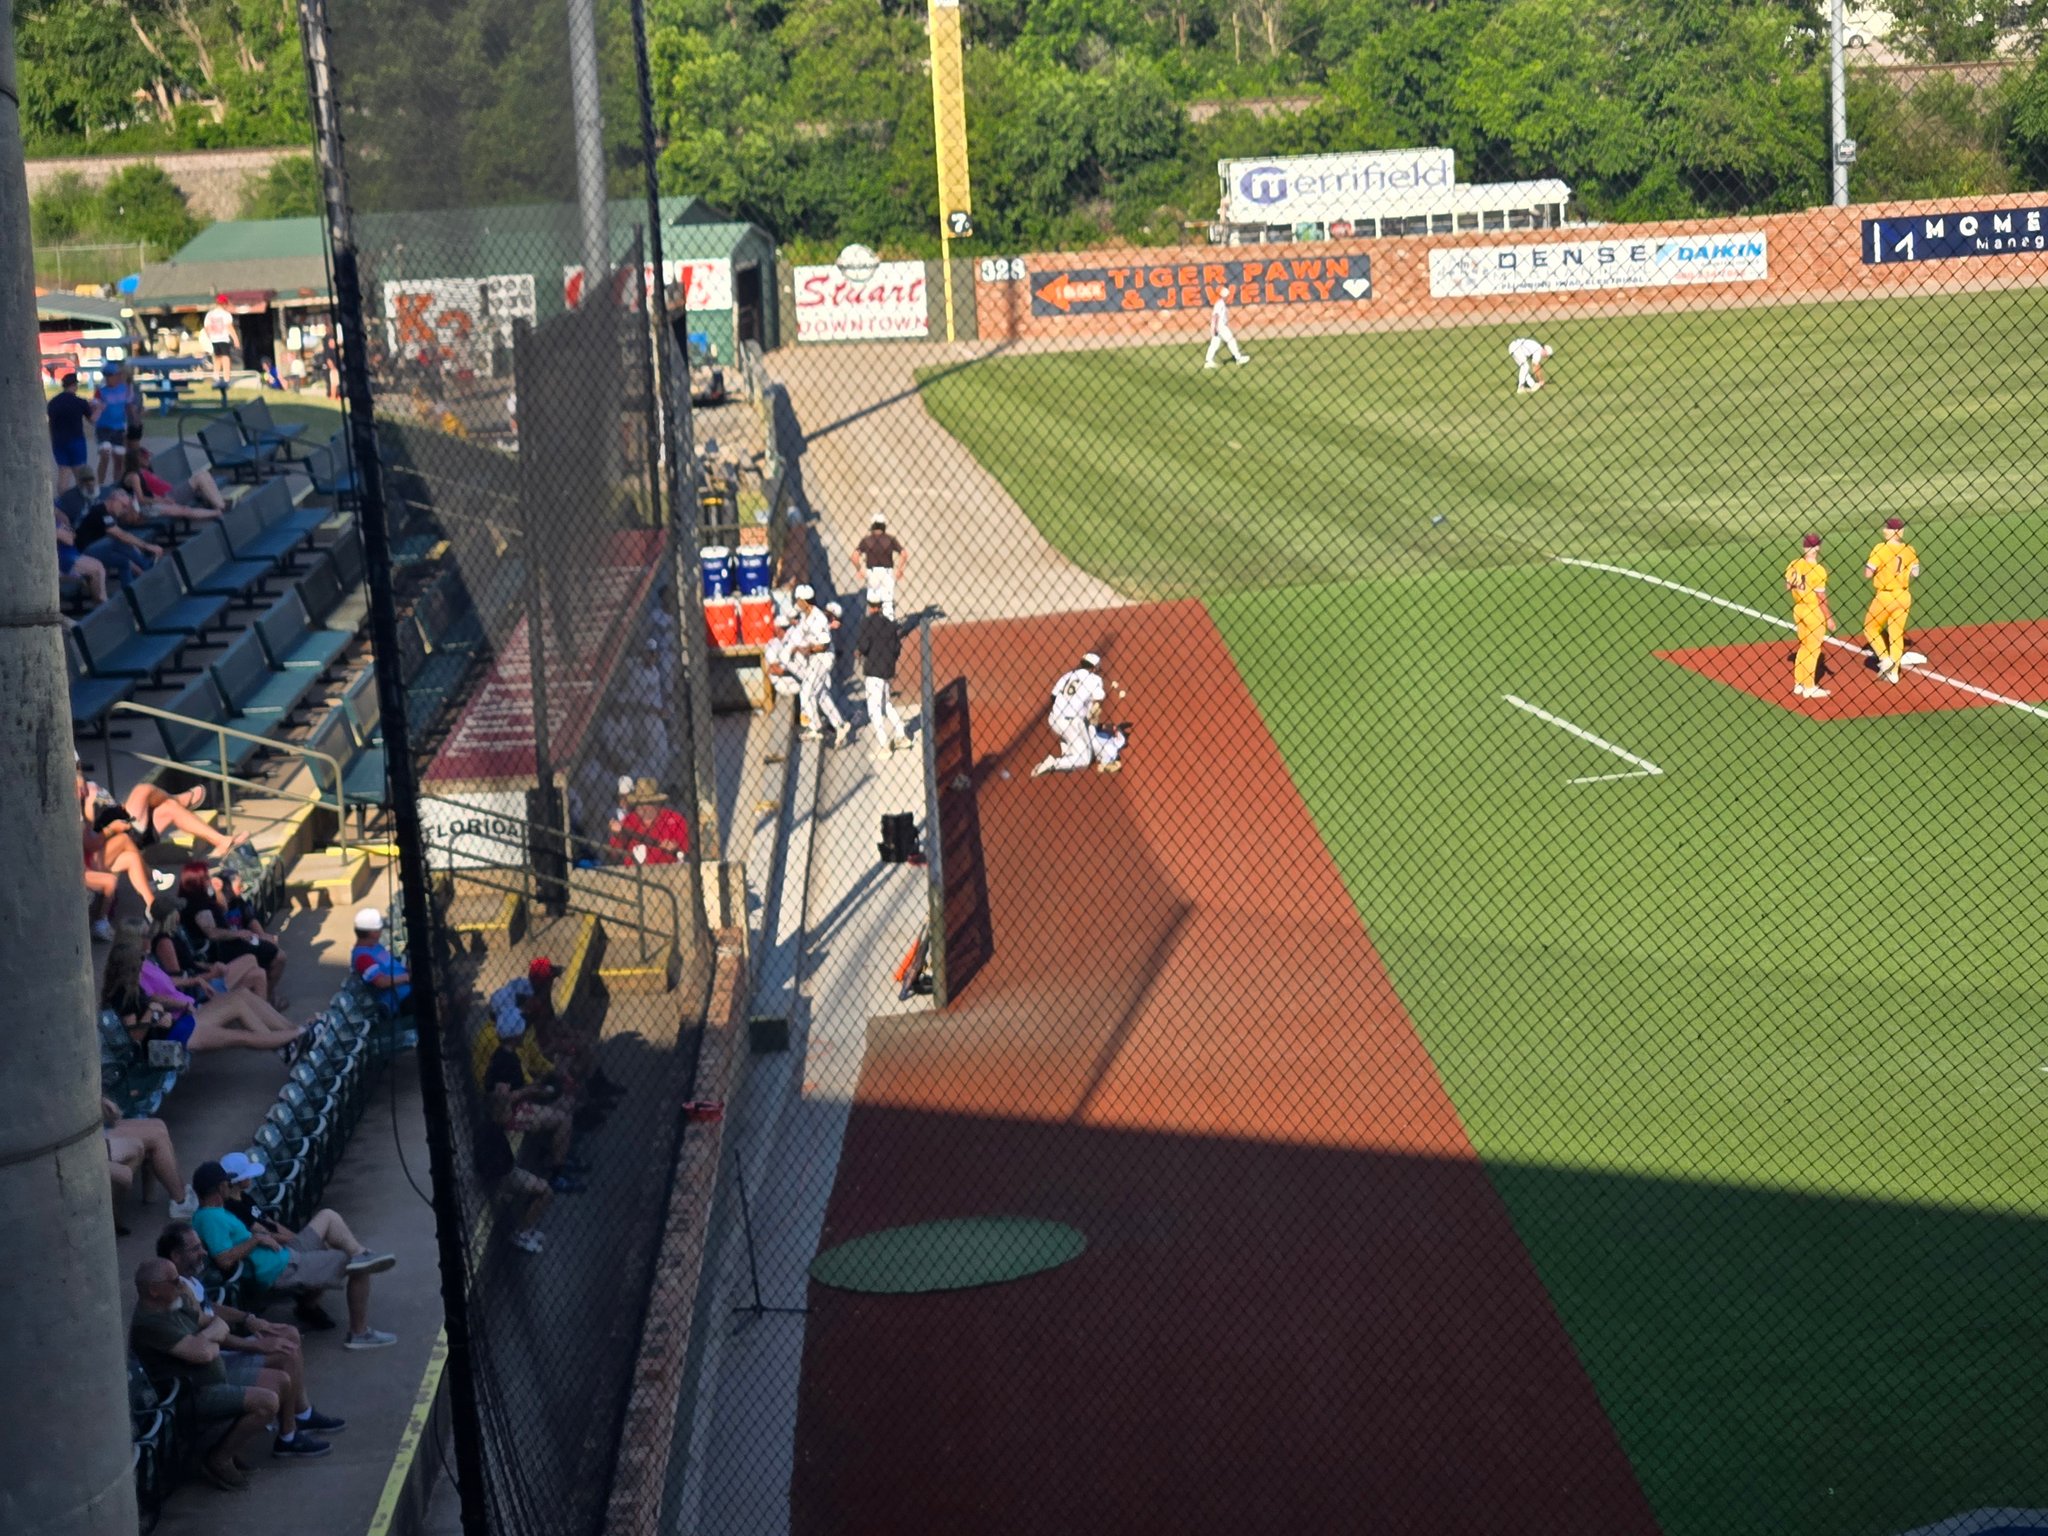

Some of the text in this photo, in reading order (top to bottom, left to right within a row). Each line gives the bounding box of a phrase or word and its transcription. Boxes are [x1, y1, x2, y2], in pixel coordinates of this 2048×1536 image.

[1499, 245, 1646, 269] DENSE
[1677, 241, 1762, 262] DAIKIN
[1108, 258, 1349, 289] TIGER PAWN
[796, 275, 924, 307] Stuart
[1121, 278, 1335, 310] & JEWELRY
[796, 315, 929, 334] DOWNTOWN
